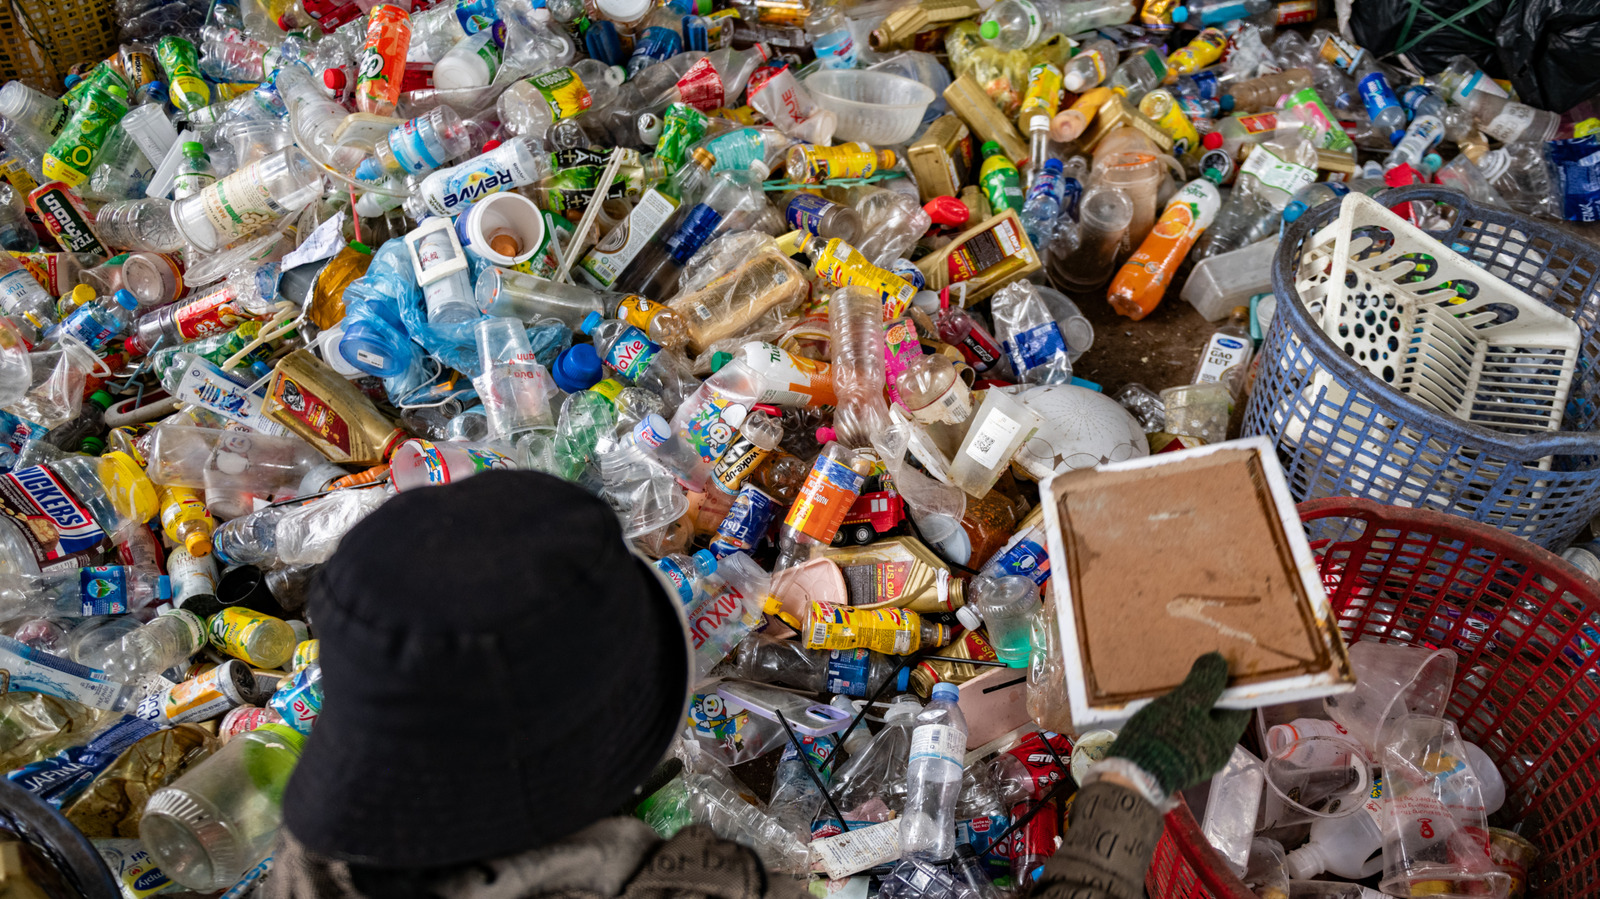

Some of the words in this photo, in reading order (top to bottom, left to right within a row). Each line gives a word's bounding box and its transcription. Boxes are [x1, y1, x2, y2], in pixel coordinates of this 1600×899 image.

[444, 169, 514, 209] ReVive
[70, 233, 95, 252] TEA
[724, 452, 759, 483] wake-up
[887, 564, 896, 580] US
[982, 645, 995, 659] US
